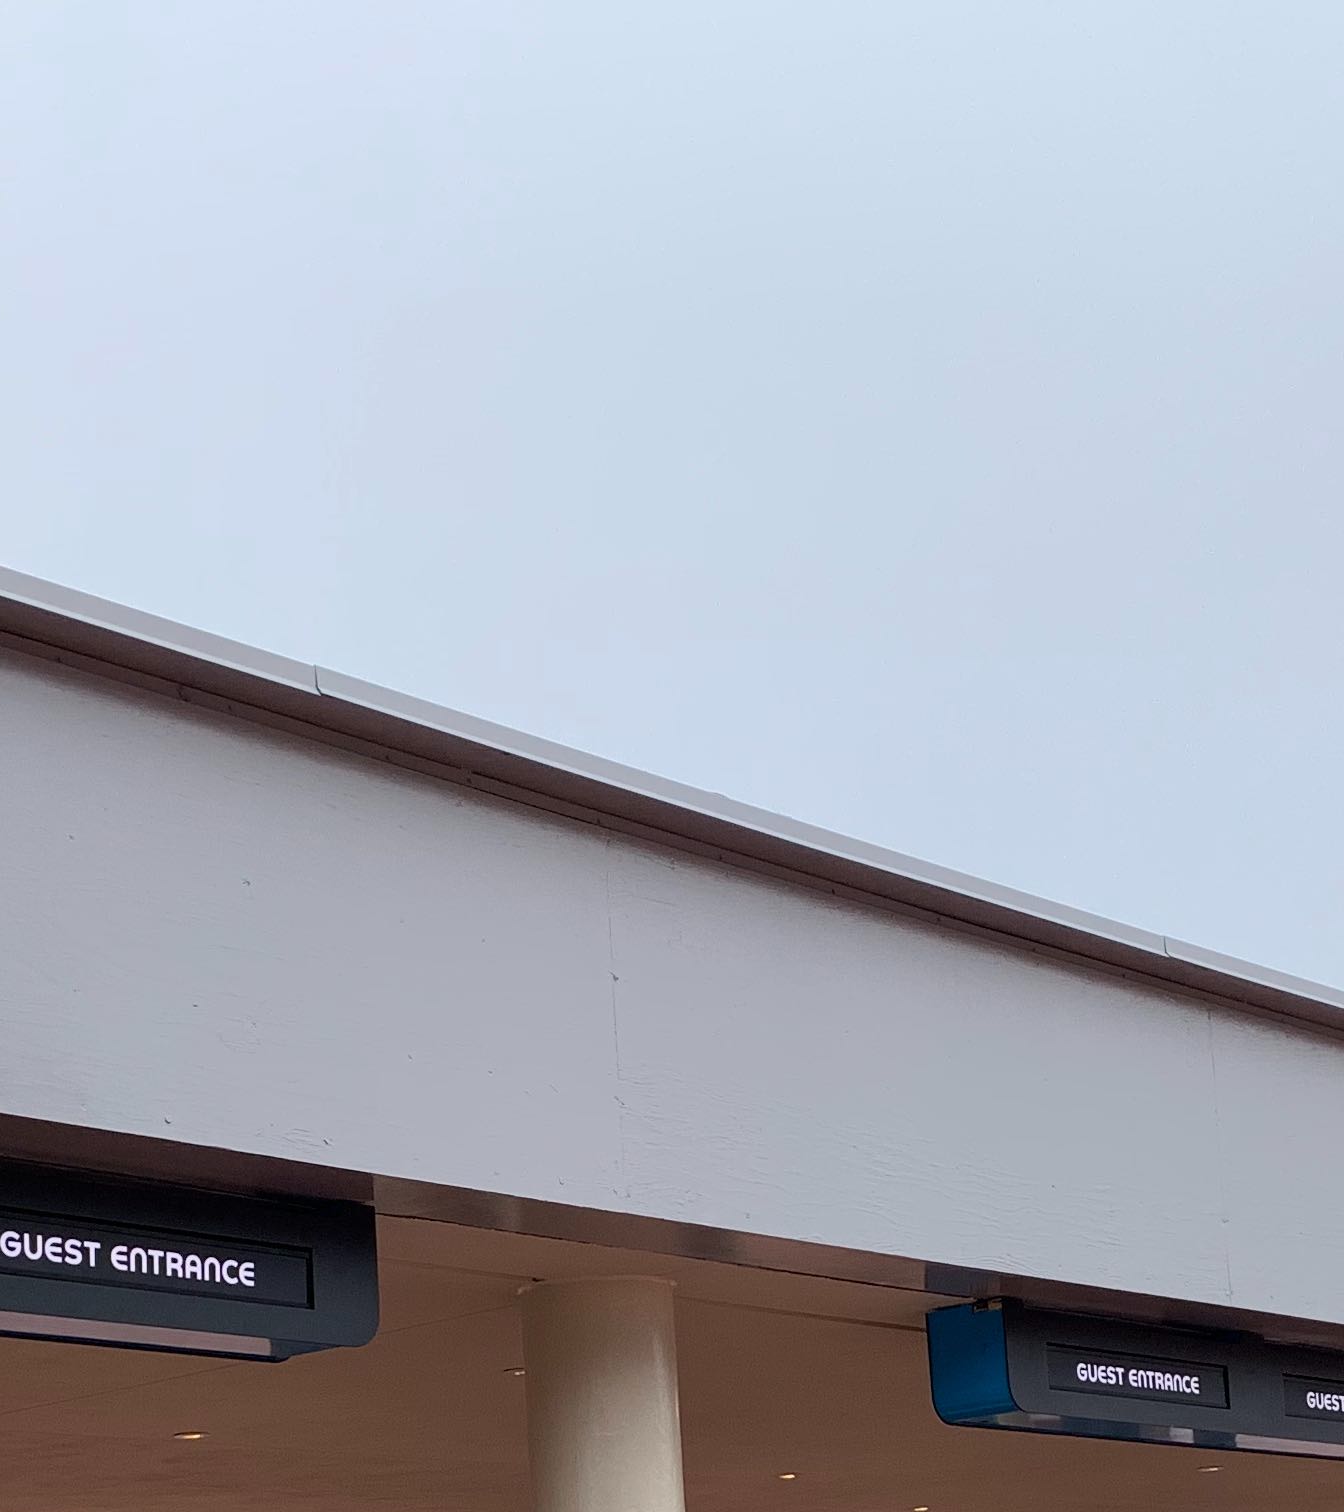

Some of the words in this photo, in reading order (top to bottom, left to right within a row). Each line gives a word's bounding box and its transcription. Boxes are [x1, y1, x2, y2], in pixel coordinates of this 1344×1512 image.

[0, 1230, 101, 1268] GUEST
[110, 1245, 255, 1287] ENTRANCE
[1076, 1362, 1125, 1386] GUEST
[1128, 1368, 1200, 1395] ENTRANCE
